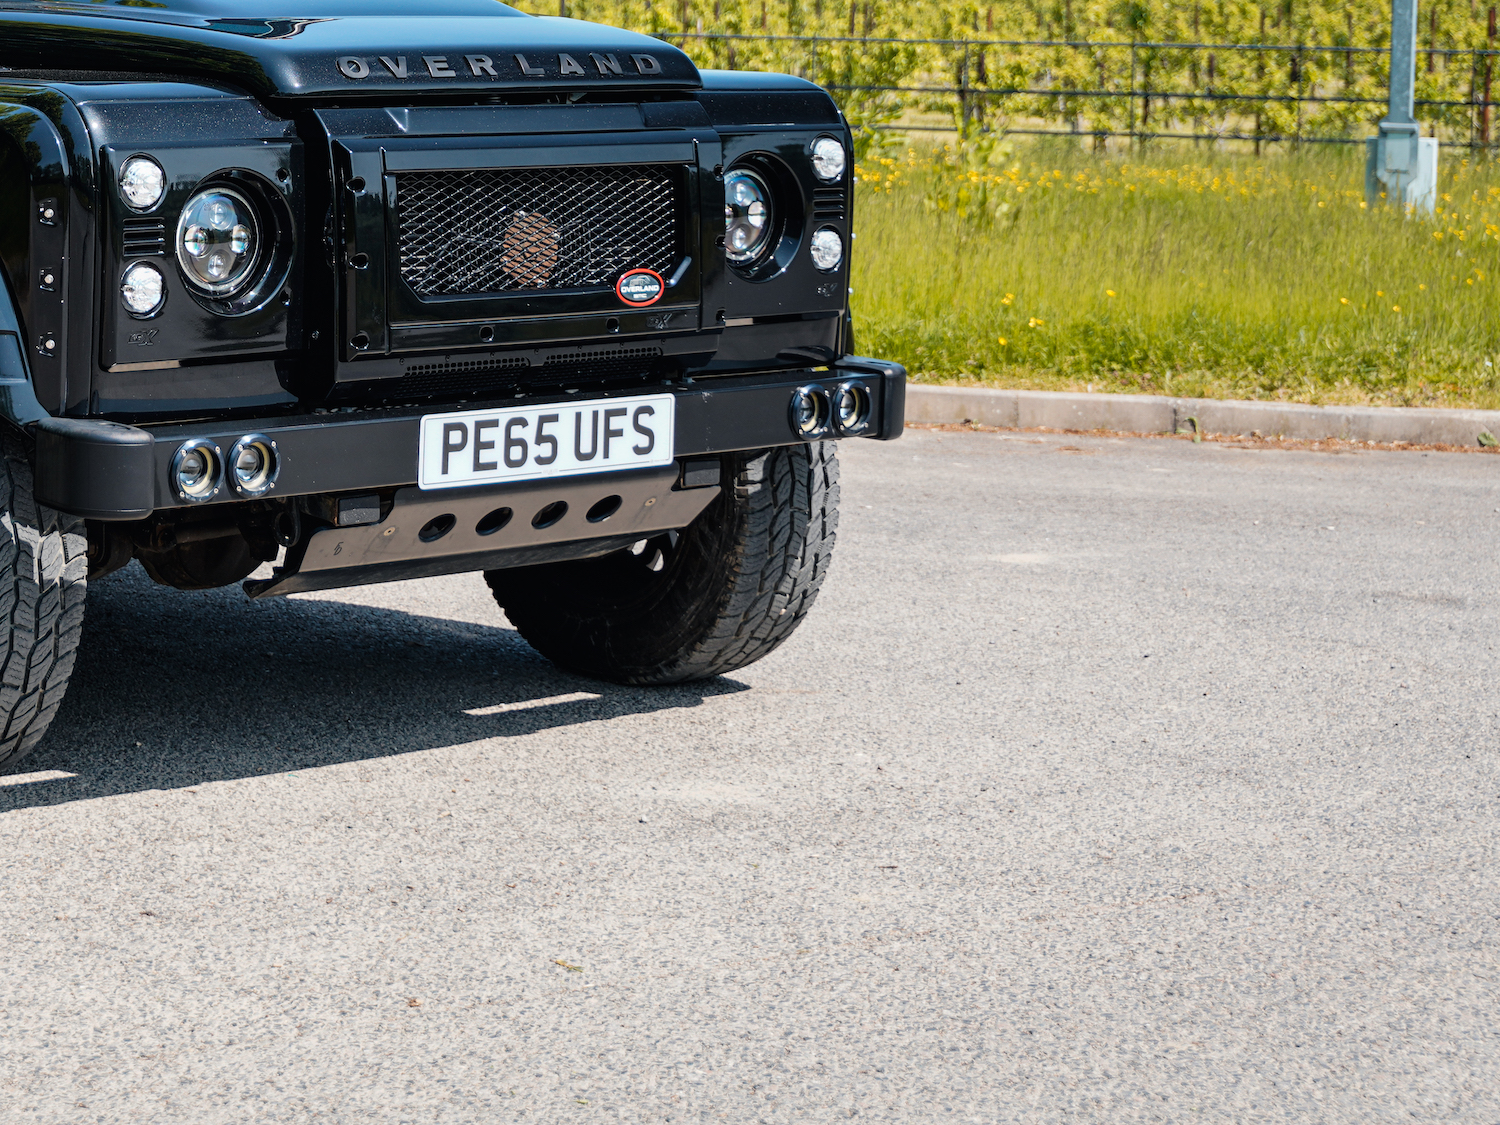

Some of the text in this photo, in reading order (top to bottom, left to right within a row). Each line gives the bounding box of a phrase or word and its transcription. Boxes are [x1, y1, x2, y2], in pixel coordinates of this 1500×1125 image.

[337, 53, 661, 79] OVERLAND
[620, 284, 660, 294] OVERLAND
[441, 405, 655, 475] PE65 UFS
